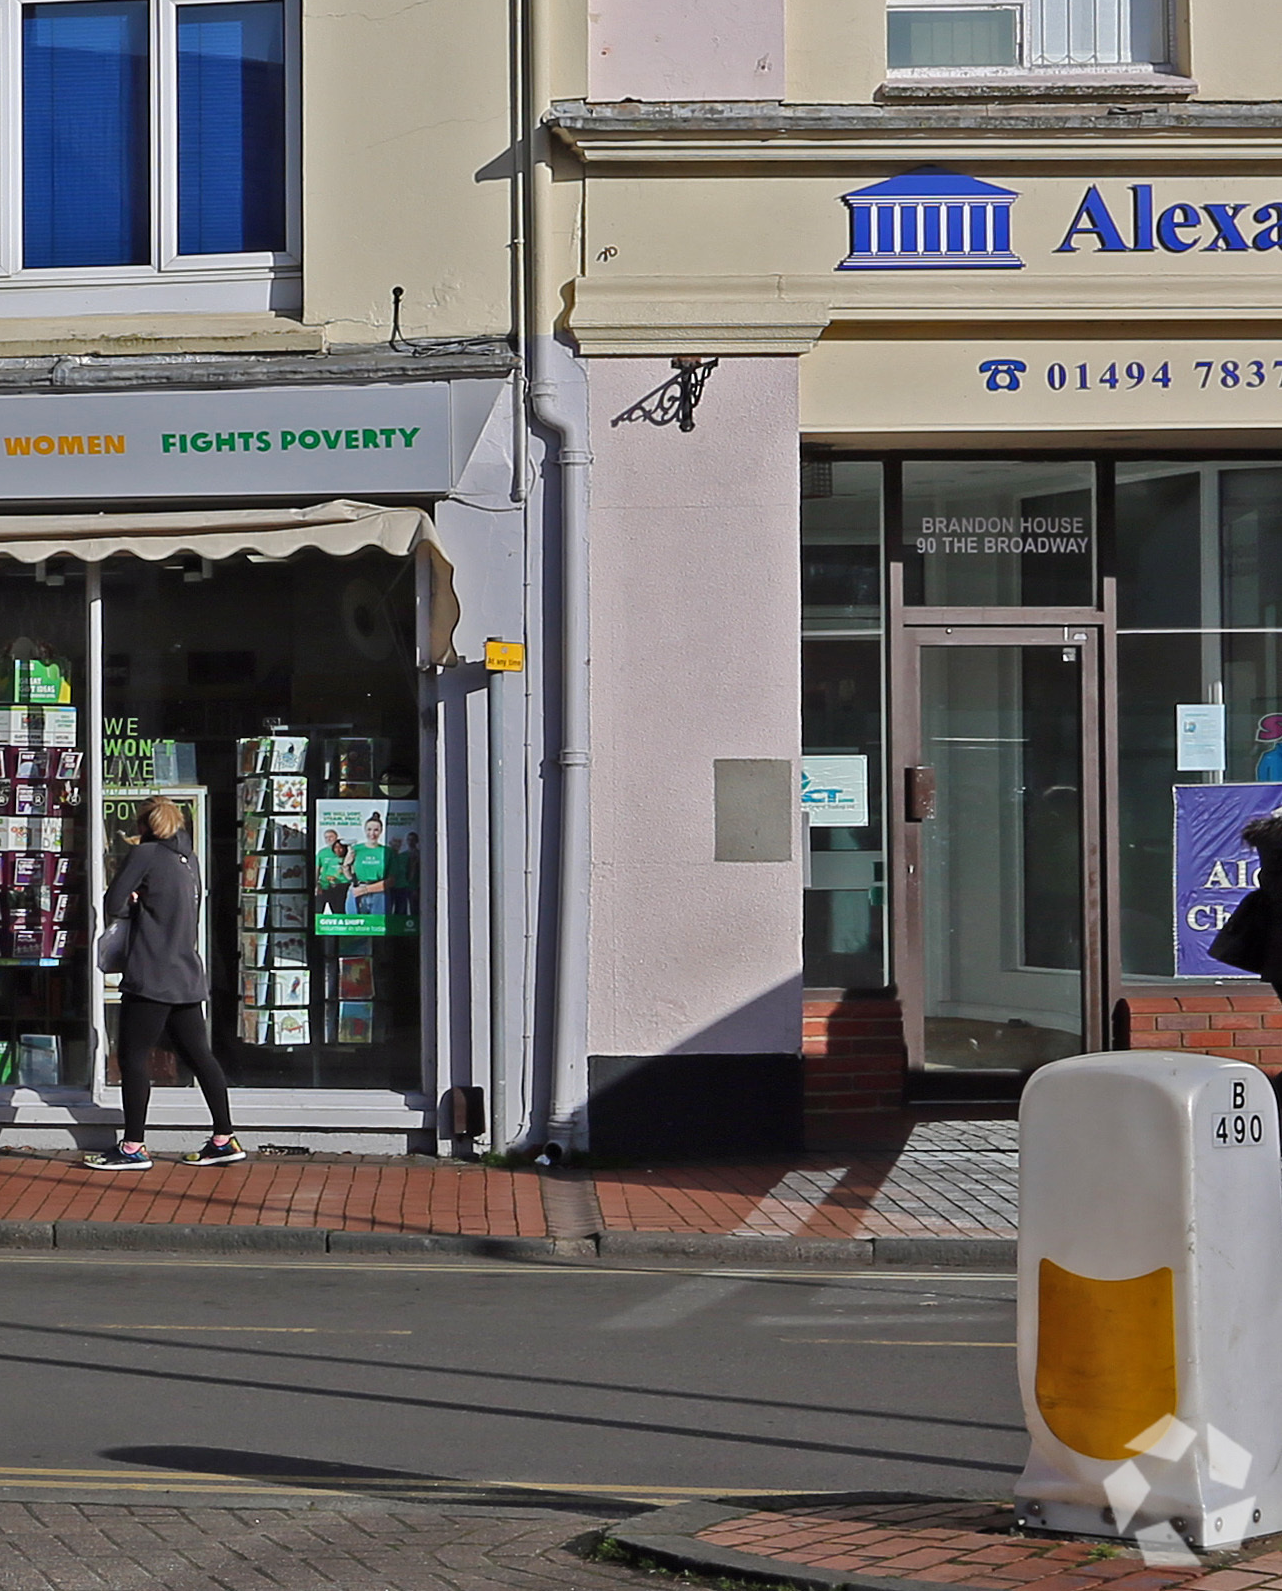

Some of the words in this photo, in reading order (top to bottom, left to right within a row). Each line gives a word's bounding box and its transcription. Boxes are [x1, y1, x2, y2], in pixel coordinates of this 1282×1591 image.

[1046, 361, 1172, 390] 01494
[5, 434, 126, 457] WOMEN
[161, 430, 272, 454] FIGHTS
[281, 426, 422, 451] POVERTY
[921, 517, 1014, 534] BRANDON
[1019, 517, 1084, 534] HOUSE
[916, 537, 937, 555] 90
[942, 537, 979, 555] THE
[983, 537, 1089, 555] BROADWAY
[104, 718, 139, 736] WE
[104, 760, 154, 779] LIVE
[1231, 1081, 1246, 1110] B
[1214, 1114, 1263, 1145] 490
